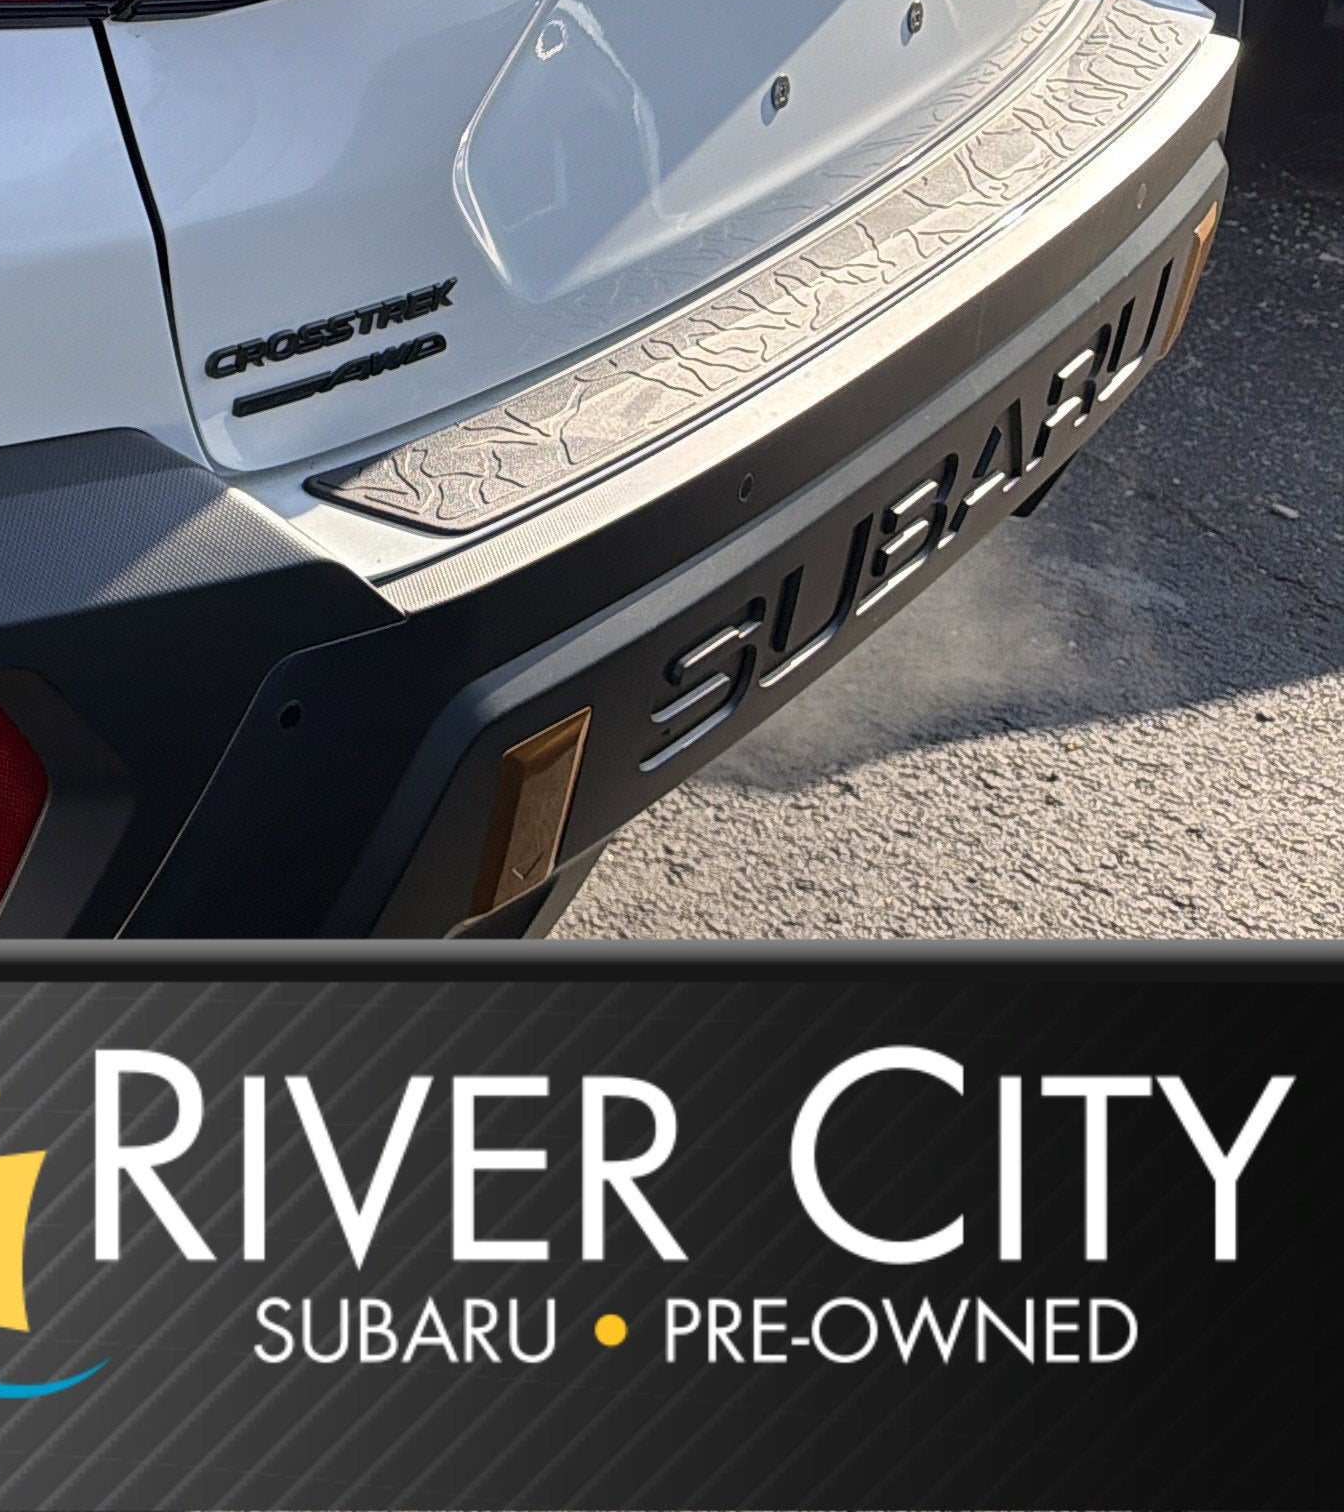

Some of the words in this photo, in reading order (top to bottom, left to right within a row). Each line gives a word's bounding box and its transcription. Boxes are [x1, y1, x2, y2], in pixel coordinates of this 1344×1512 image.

[205, 276, 459, 379] CROSSTREK
[320, 331, 448, 393] AWD
[638, 256, 1175, 773] SUBARU
